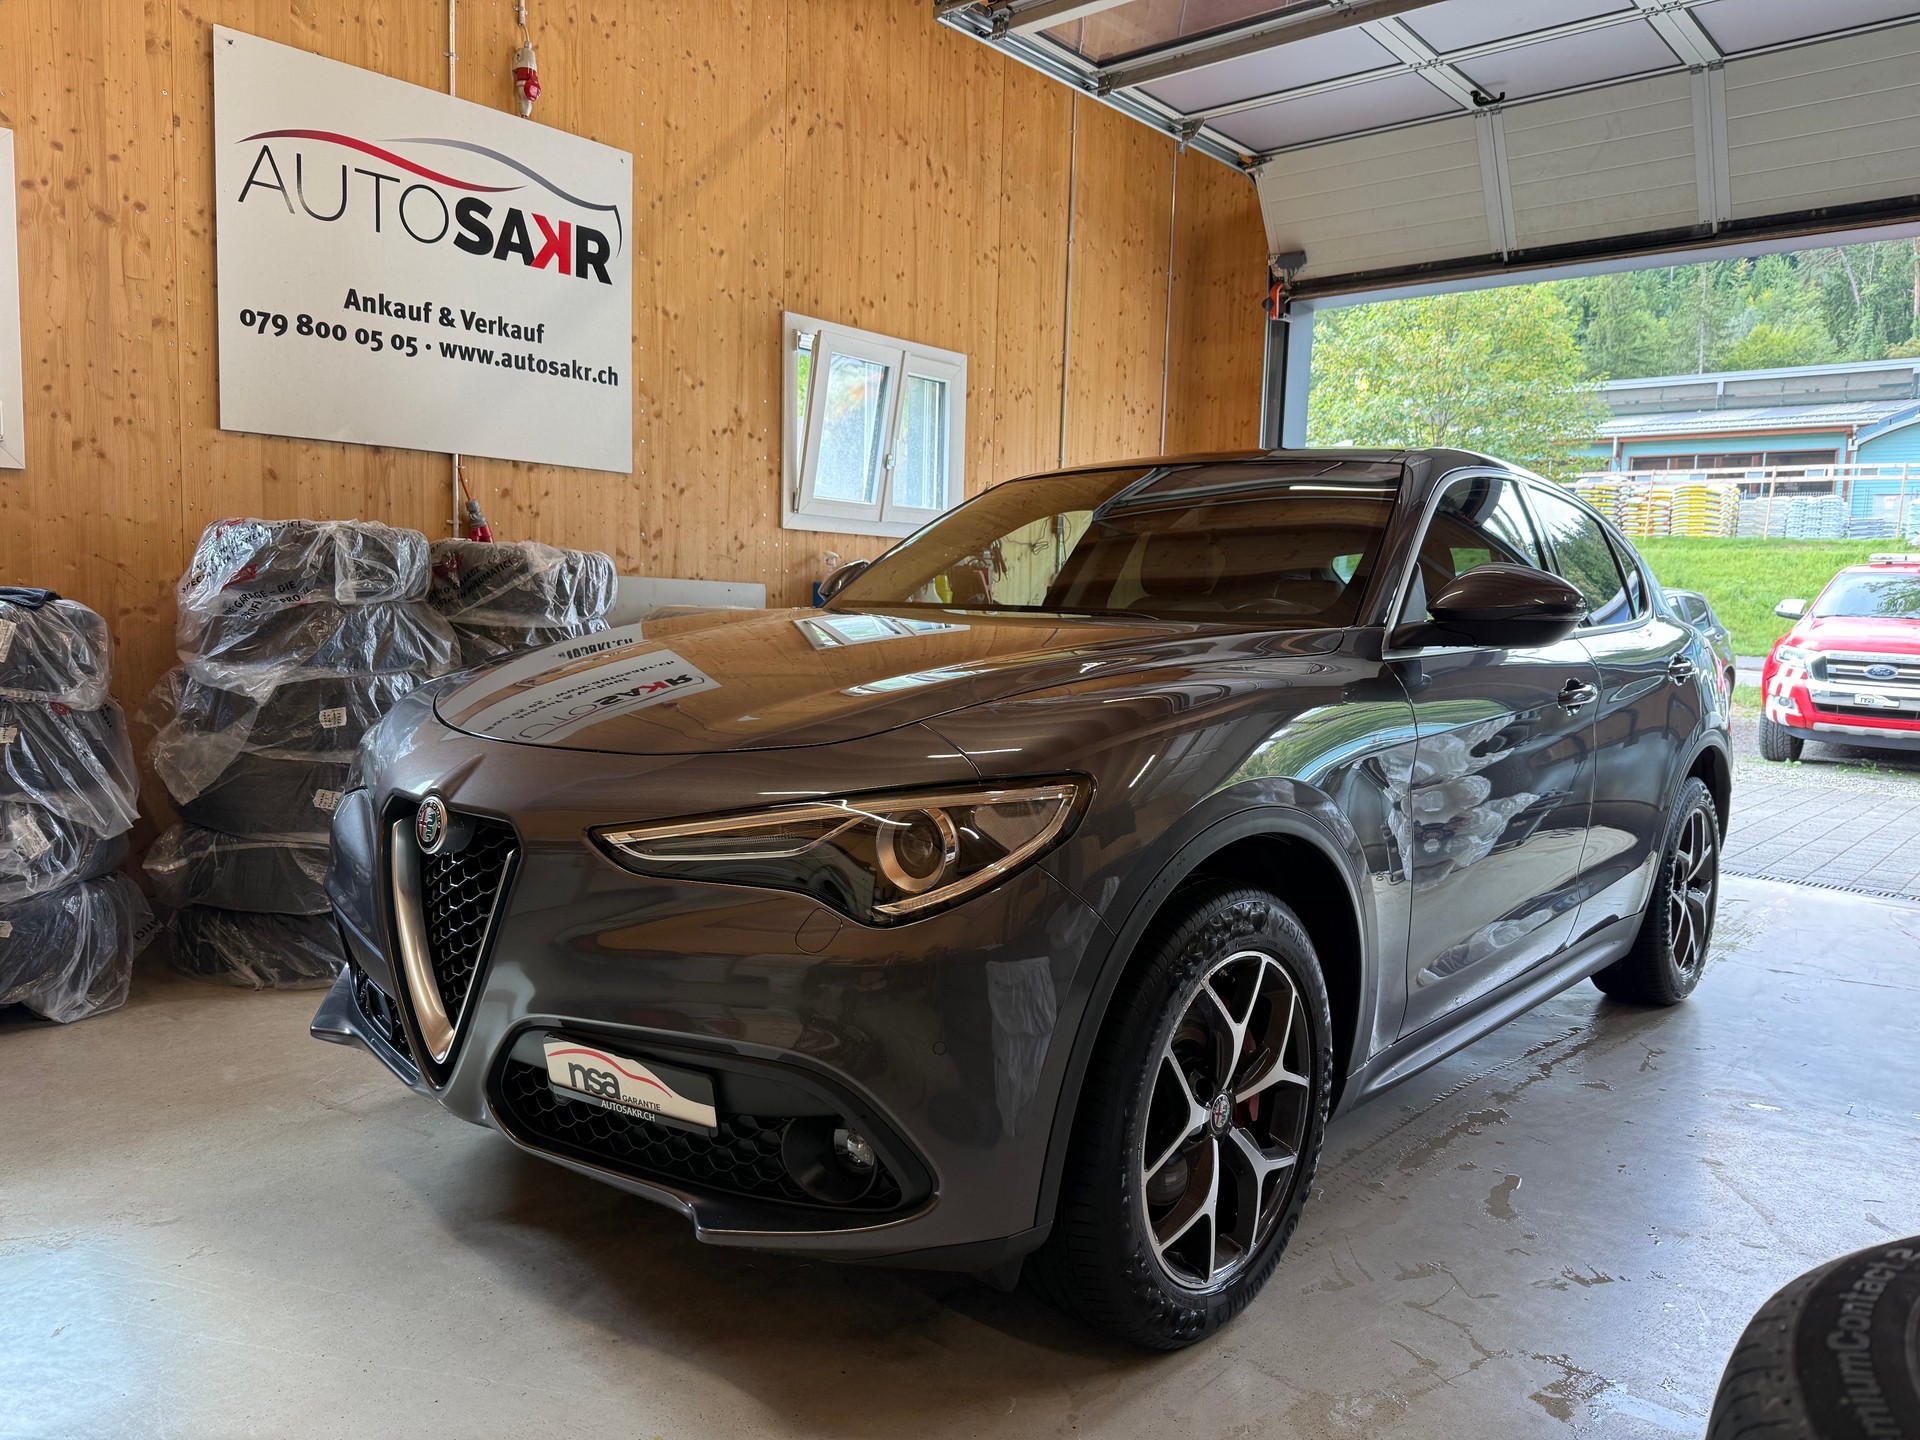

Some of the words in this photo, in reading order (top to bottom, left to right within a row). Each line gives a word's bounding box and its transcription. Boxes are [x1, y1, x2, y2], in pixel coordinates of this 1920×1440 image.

[237, 144, 612, 285] AUTOSAKR
[343, 288, 432, 324] Ankauf
[438, 306, 456, 328] &
[460, 309, 545, 344] Verkauf
[239, 308, 288, 337] 079
[296, 313, 347, 341] 800
[355, 328, 383, 352] 05
[391, 333, 418, 357] 05
[438, 341, 619, 386] www.autosakr.ch
[234, 589, 268, 610] GARAGE
[278, 580, 297, 594] DIE
[568, 1062, 621, 1100] nsa
[622, 1094, 661, 1111] GARANTIE
[601, 1100, 656, 1122] AUTOSAKR.CH
[1826, 1261, 1906, 1440] miumContact
